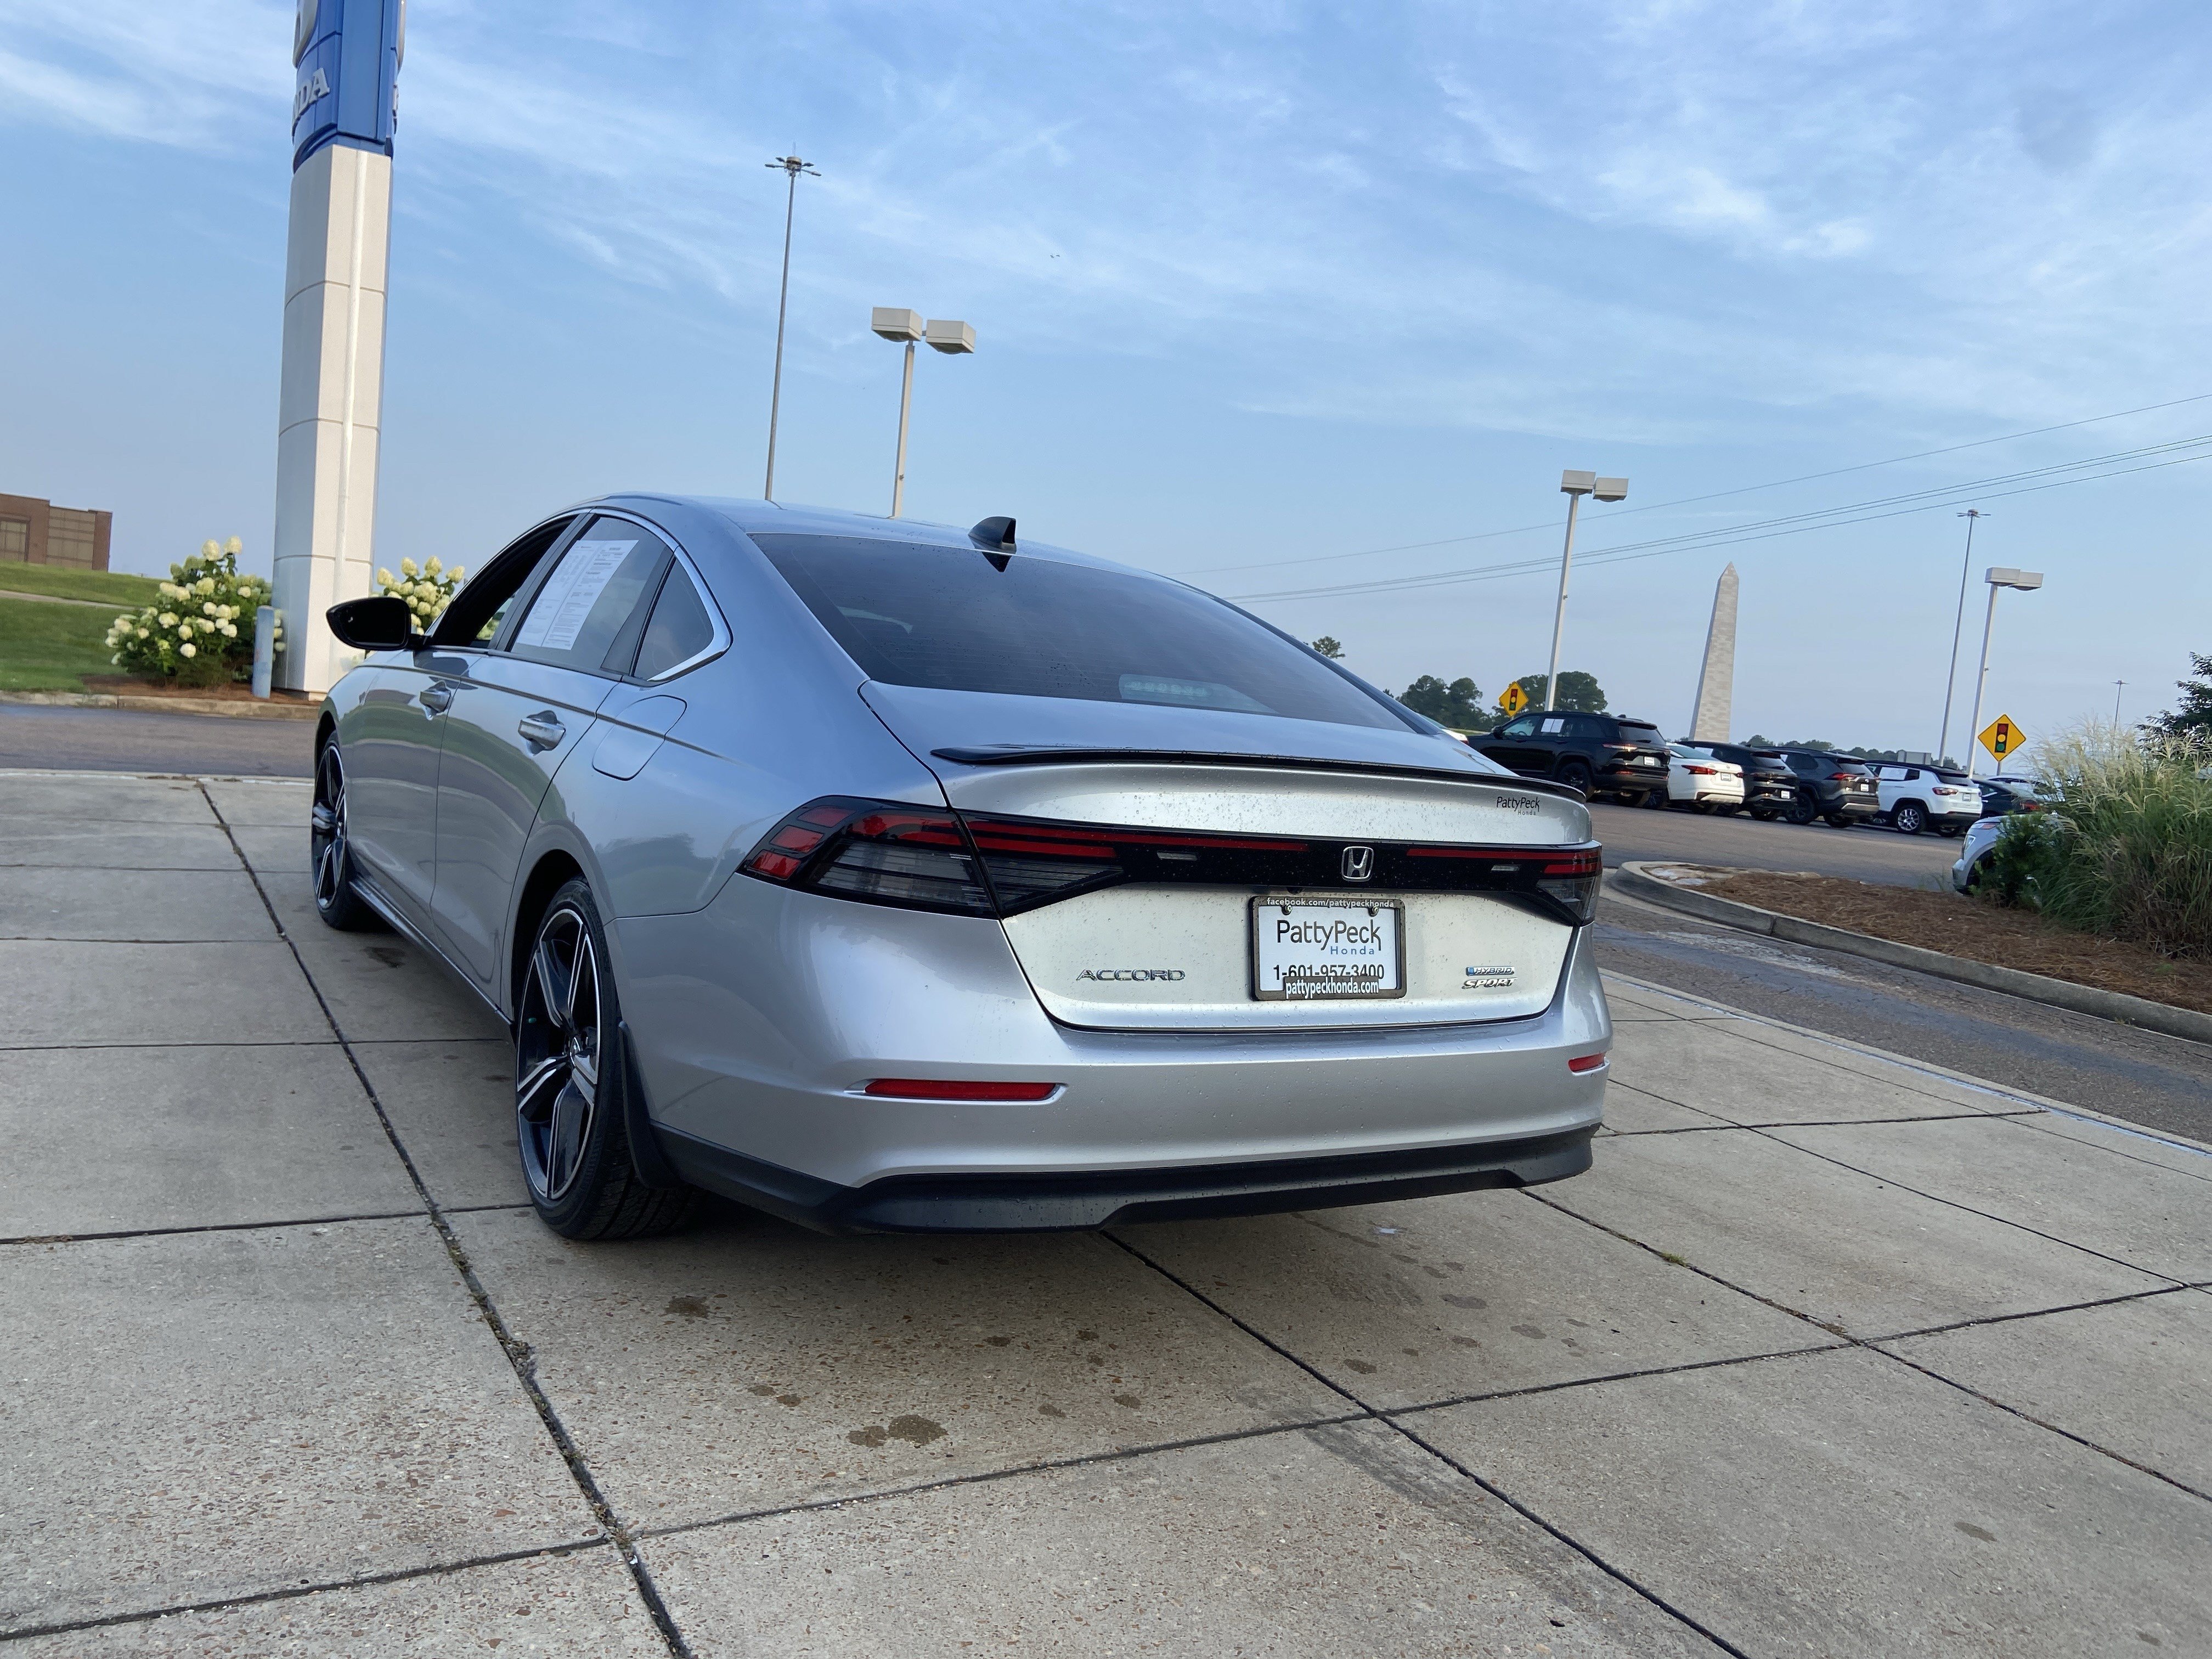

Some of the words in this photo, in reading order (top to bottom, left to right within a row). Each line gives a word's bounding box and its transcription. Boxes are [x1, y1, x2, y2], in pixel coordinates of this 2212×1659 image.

[1496, 796, 1541, 812] PattyPeck
[1266, 897, 1395, 908] facebook.com/pattypeckhonda
[1277, 919, 1381, 951] PattyPeck
[1330, 946, 1375, 955] Honda
[1076, 968, 1186, 981] ACCORD
[1273, 964, 1385, 980] 1-601-957-3400
[1475, 967, 1513, 975] HYBRID
[1285, 977, 1379, 999] pattypeckhonda.com
[1462, 977, 1518, 989] SPORT
